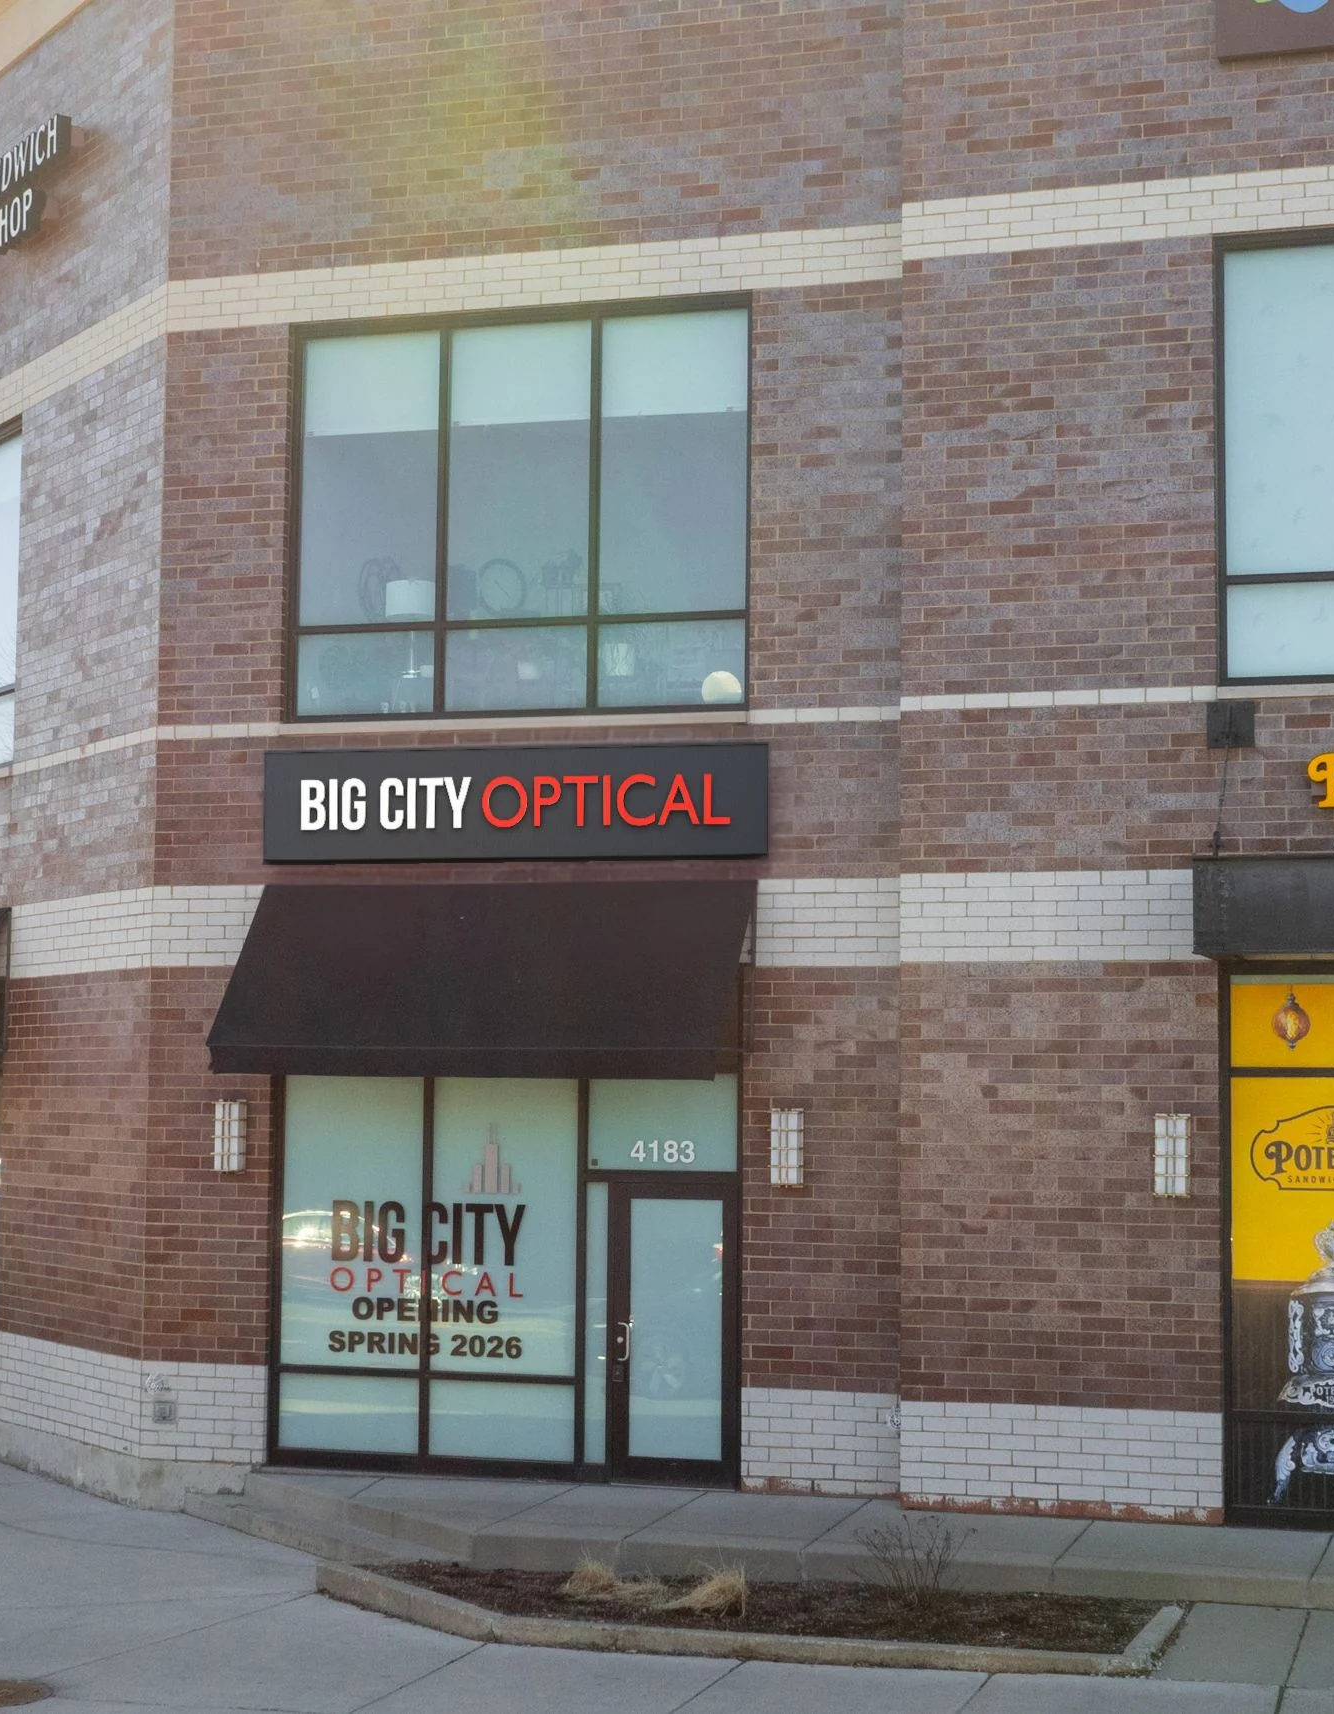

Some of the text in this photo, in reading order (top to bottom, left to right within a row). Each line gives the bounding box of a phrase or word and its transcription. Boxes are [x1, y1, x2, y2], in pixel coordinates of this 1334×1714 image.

[299, 773, 732, 831] BIG CITY OPTICAL
[630, 1139, 696, 1164] 4183
[331, 1200, 527, 1267] BIG CITY
[330, 1266, 524, 1298] OPTICAL
[450, 1334, 523, 1360] 2026
